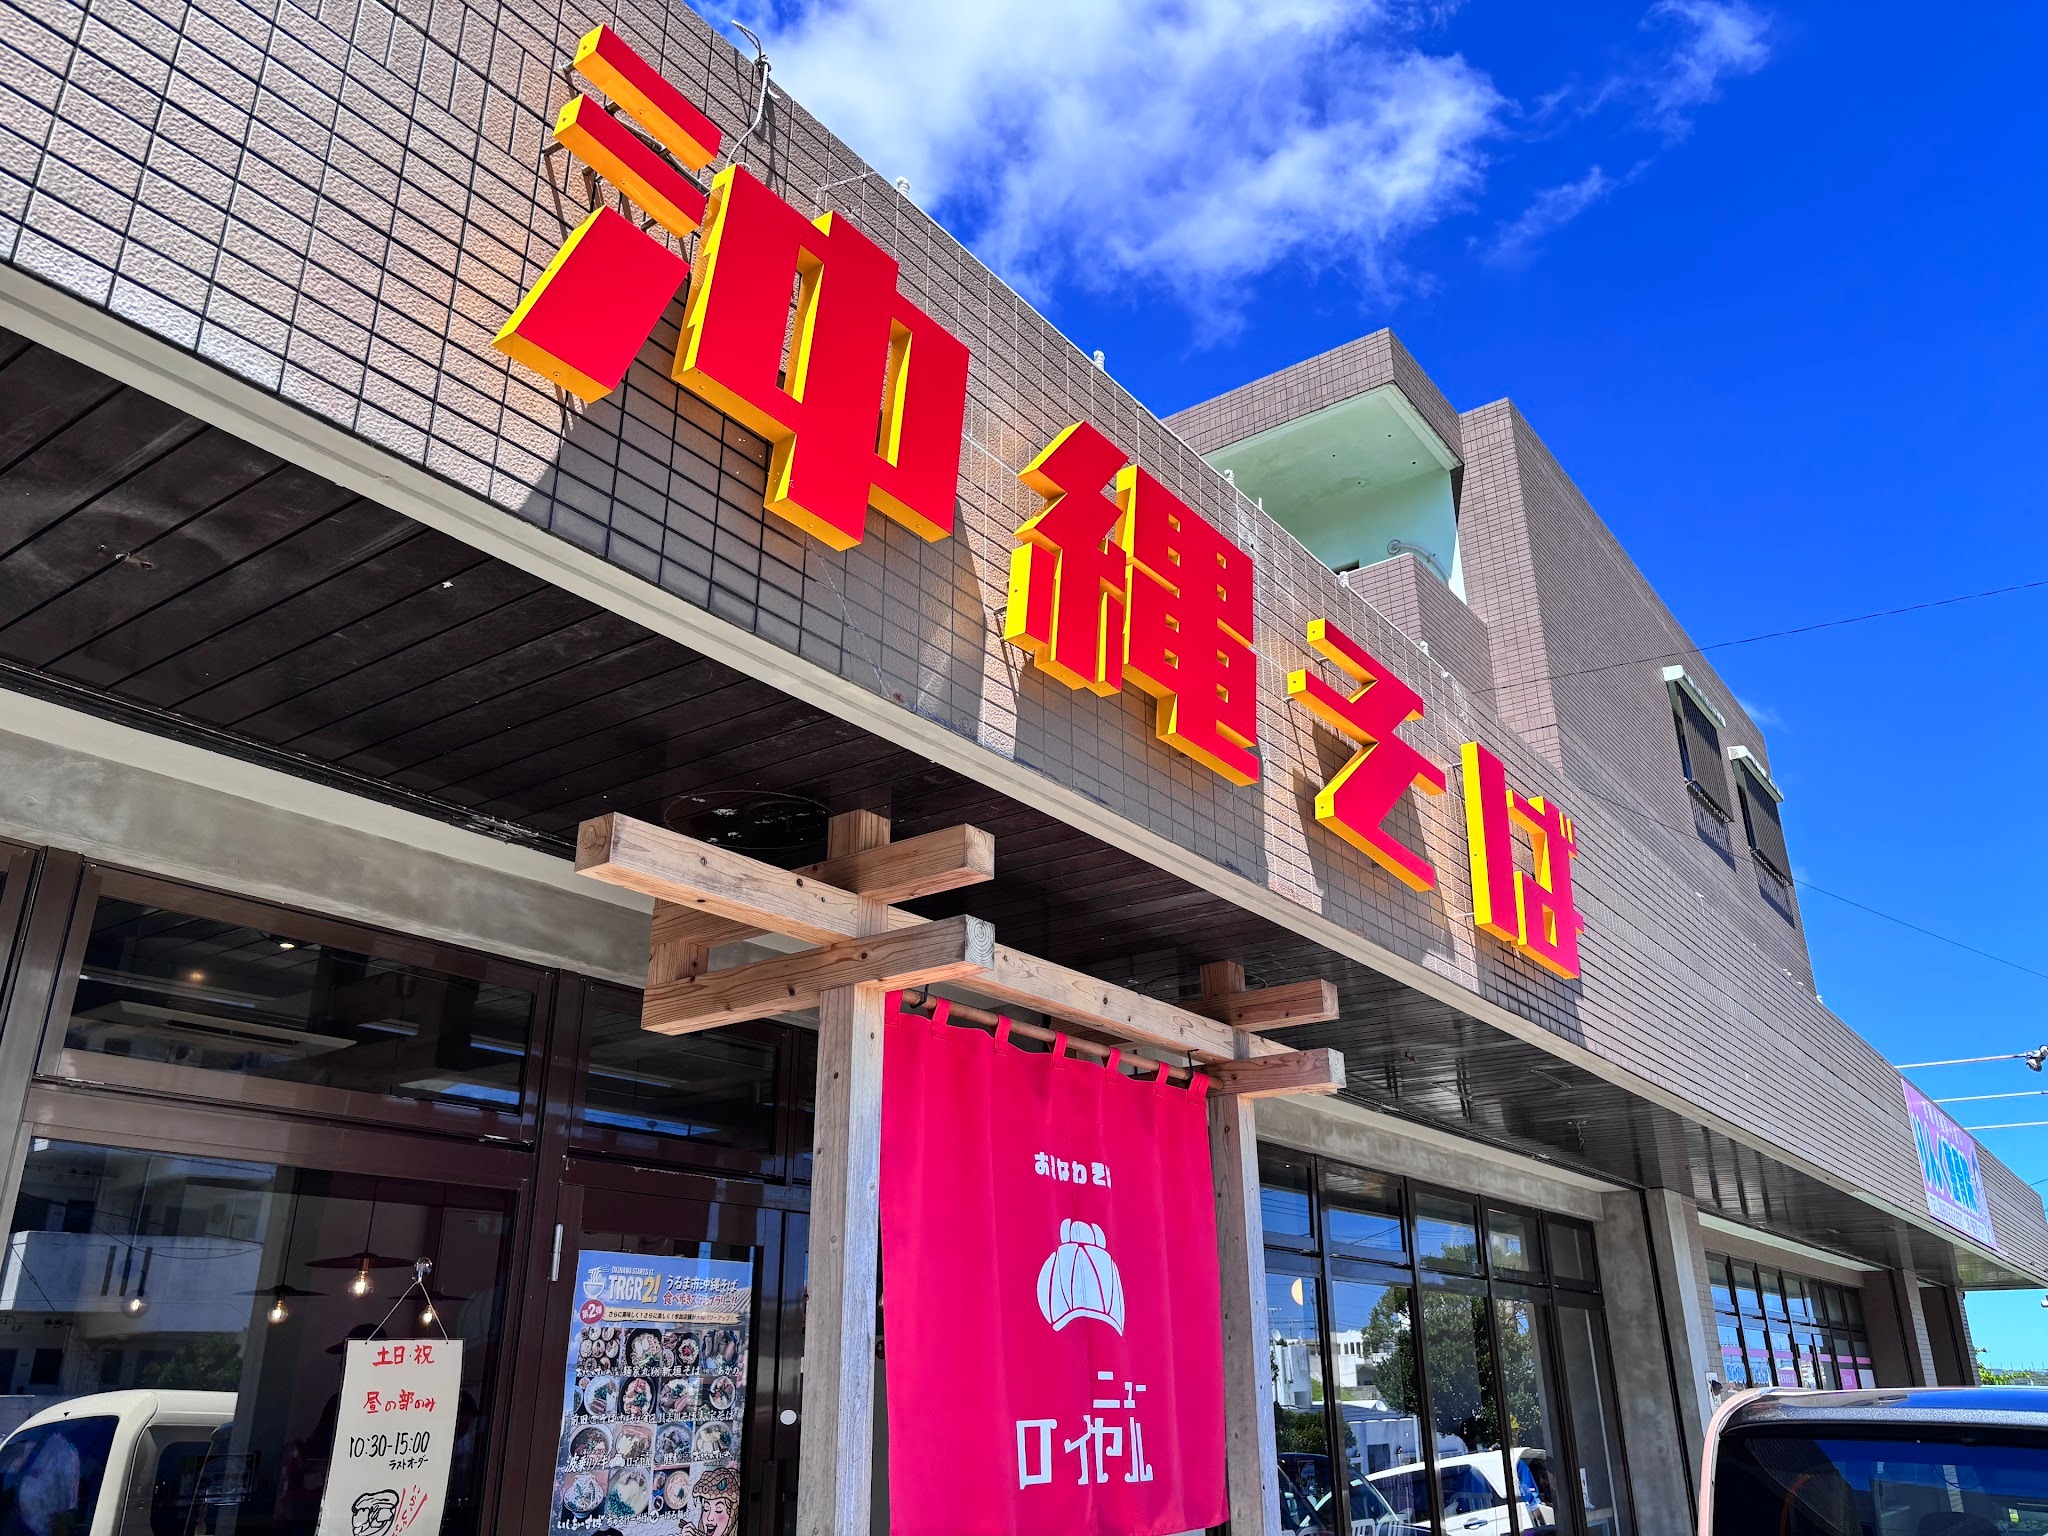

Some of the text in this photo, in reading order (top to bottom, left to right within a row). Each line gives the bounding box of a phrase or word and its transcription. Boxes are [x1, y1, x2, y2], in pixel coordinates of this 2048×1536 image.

[491, 24, 1584, 980] 沖縄そば
[666, 1274, 738, 1293] うるま市沖縄そば
[363, 1389, 437, 1414] 昼の部のみ
[1093, 1371, 1147, 1409] ニュー
[349, 1431, 431, 1458] 10:30-15:00
[1016, 1415, 1154, 1490] ロイヤル
[389, 1454, 429, 1470] ラストオーダー
